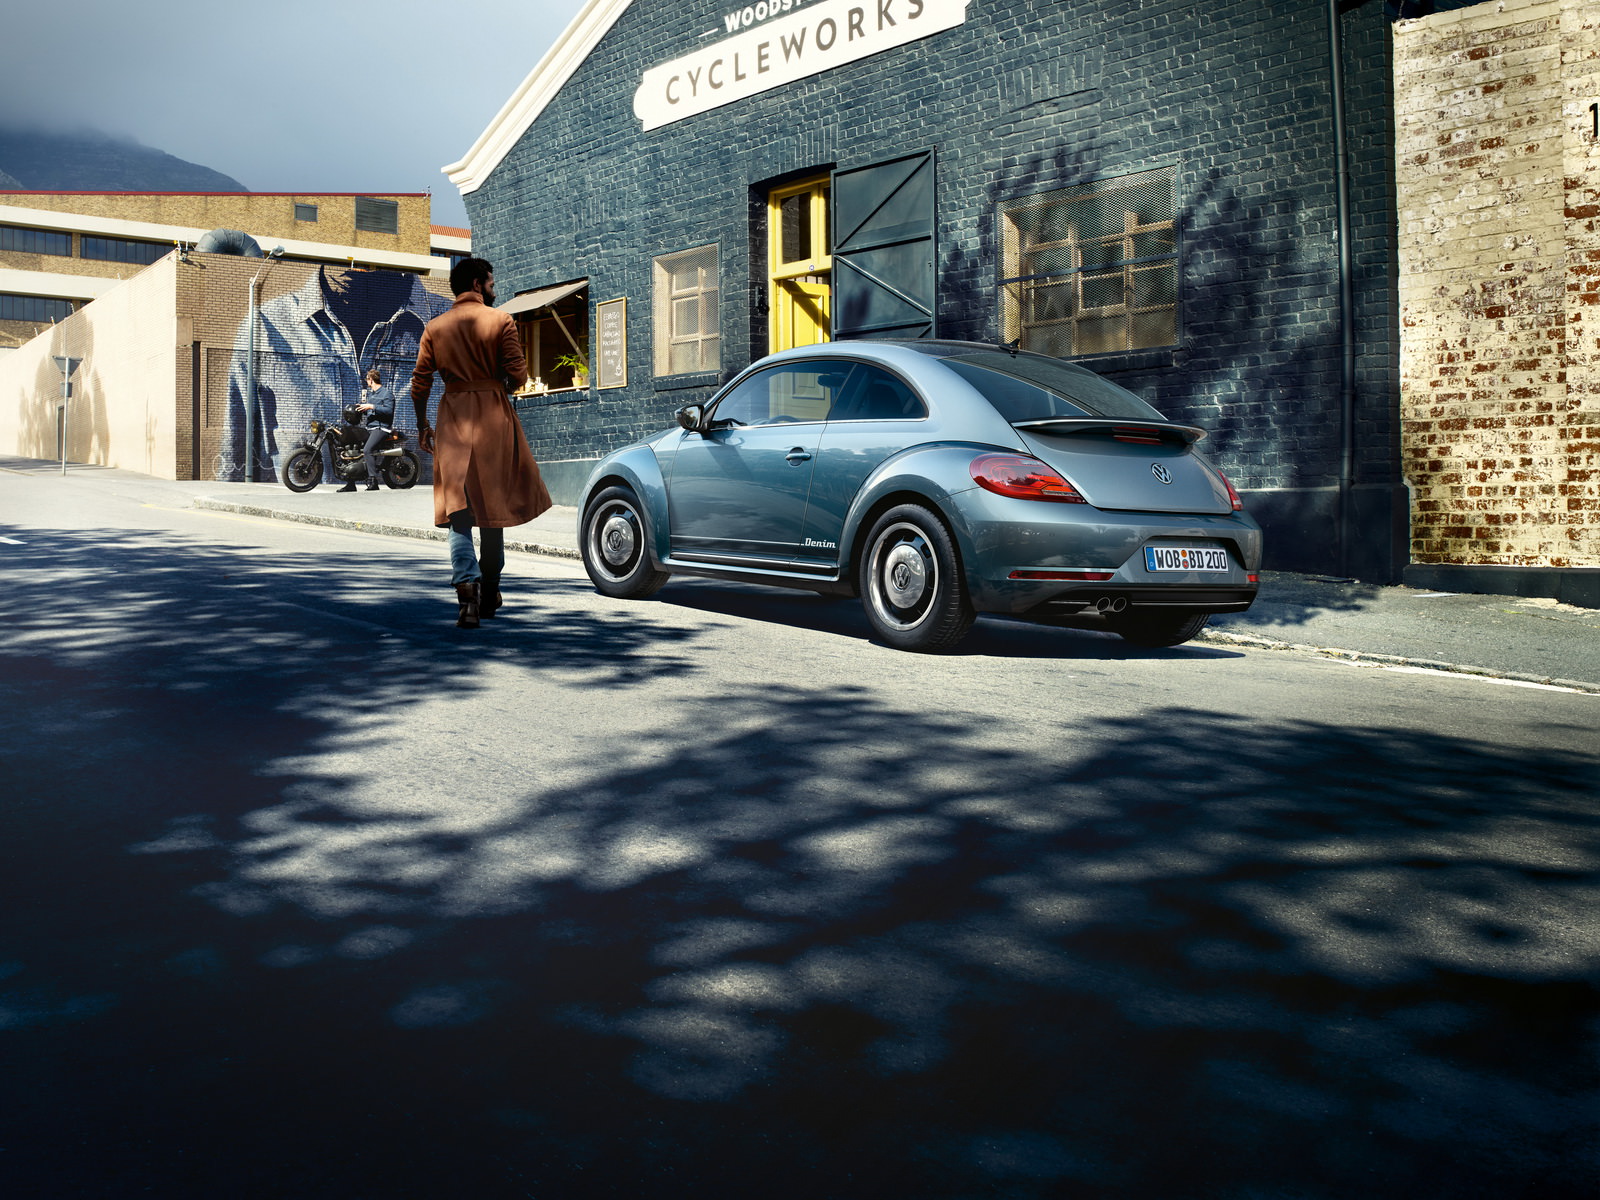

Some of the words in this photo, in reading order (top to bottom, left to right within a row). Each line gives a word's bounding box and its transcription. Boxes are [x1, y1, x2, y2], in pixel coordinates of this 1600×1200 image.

[724, 0, 802, 33] WOODS
[665, 0, 924, 105] CYCLEWORKS
[804, 537, 836, 549] Denim
[1155, 549, 1181, 569] WOB
[1188, 550, 1205, 569] BD
[1205, 551, 1227, 569] 200
